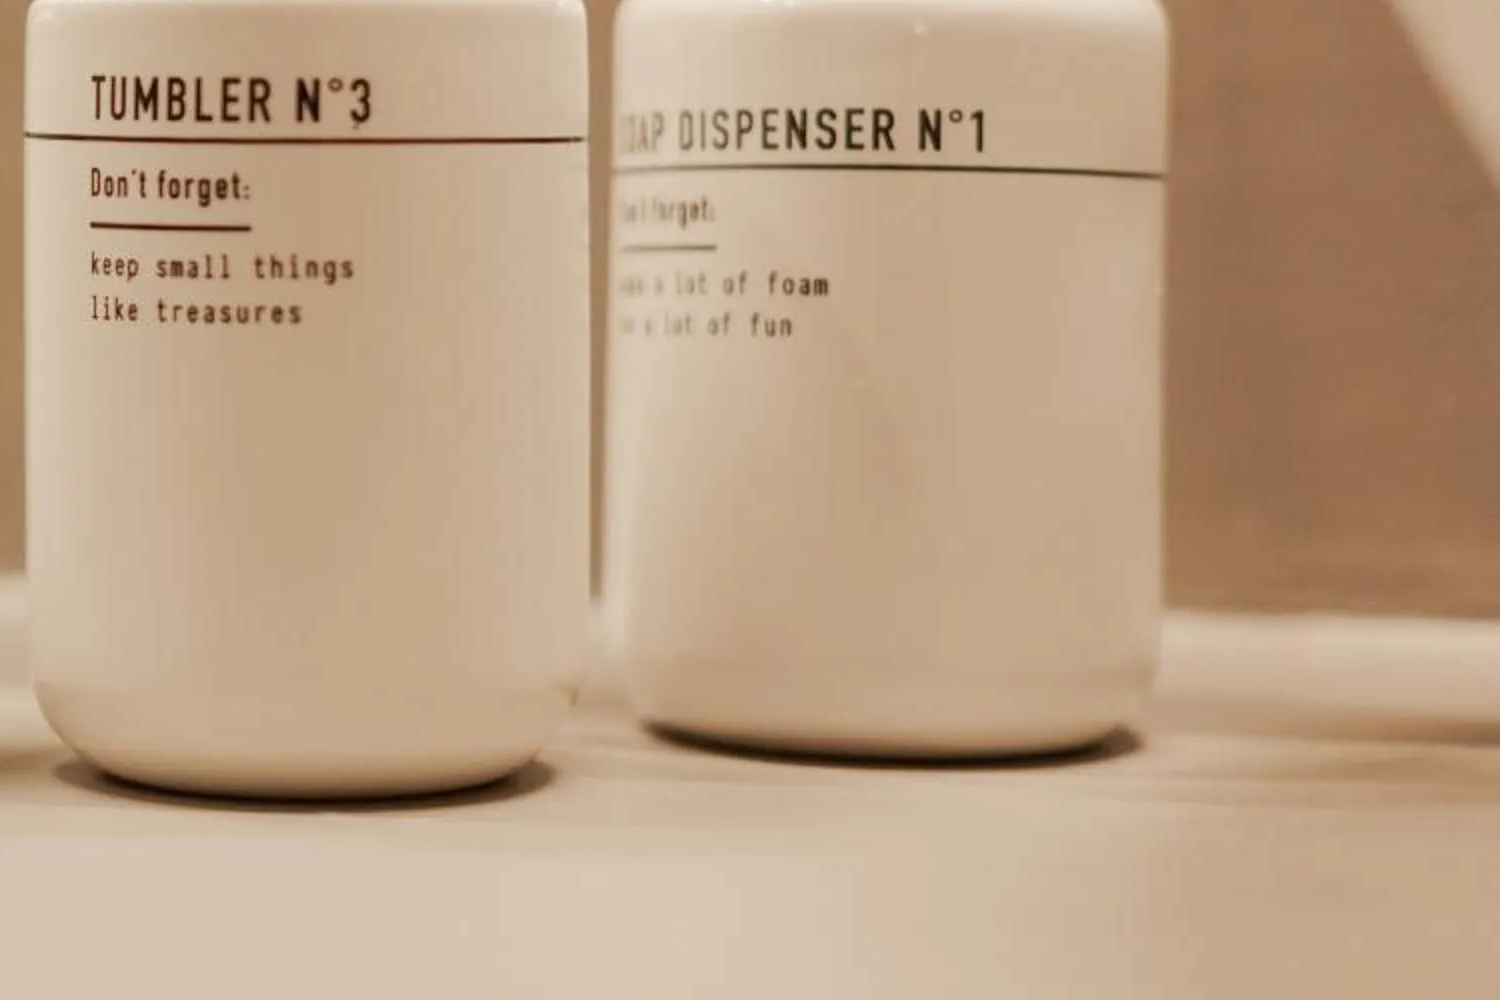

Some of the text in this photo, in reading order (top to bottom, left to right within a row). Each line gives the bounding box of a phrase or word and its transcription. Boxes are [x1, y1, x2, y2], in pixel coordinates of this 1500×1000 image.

[91, 74, 372, 124] TUMBLER N°3
[678, 107, 896, 152] DISPENSER
[918, 109, 986, 153] N°1
[90, 167, 251, 208] Don't forget:
[90, 251, 354, 286] keep small things
[723, 270, 748, 297] of
[768, 271, 830, 297] foam
[90, 296, 303, 324] like treasures
[707, 312, 732, 338] of
[750, 312, 794, 338] fun
